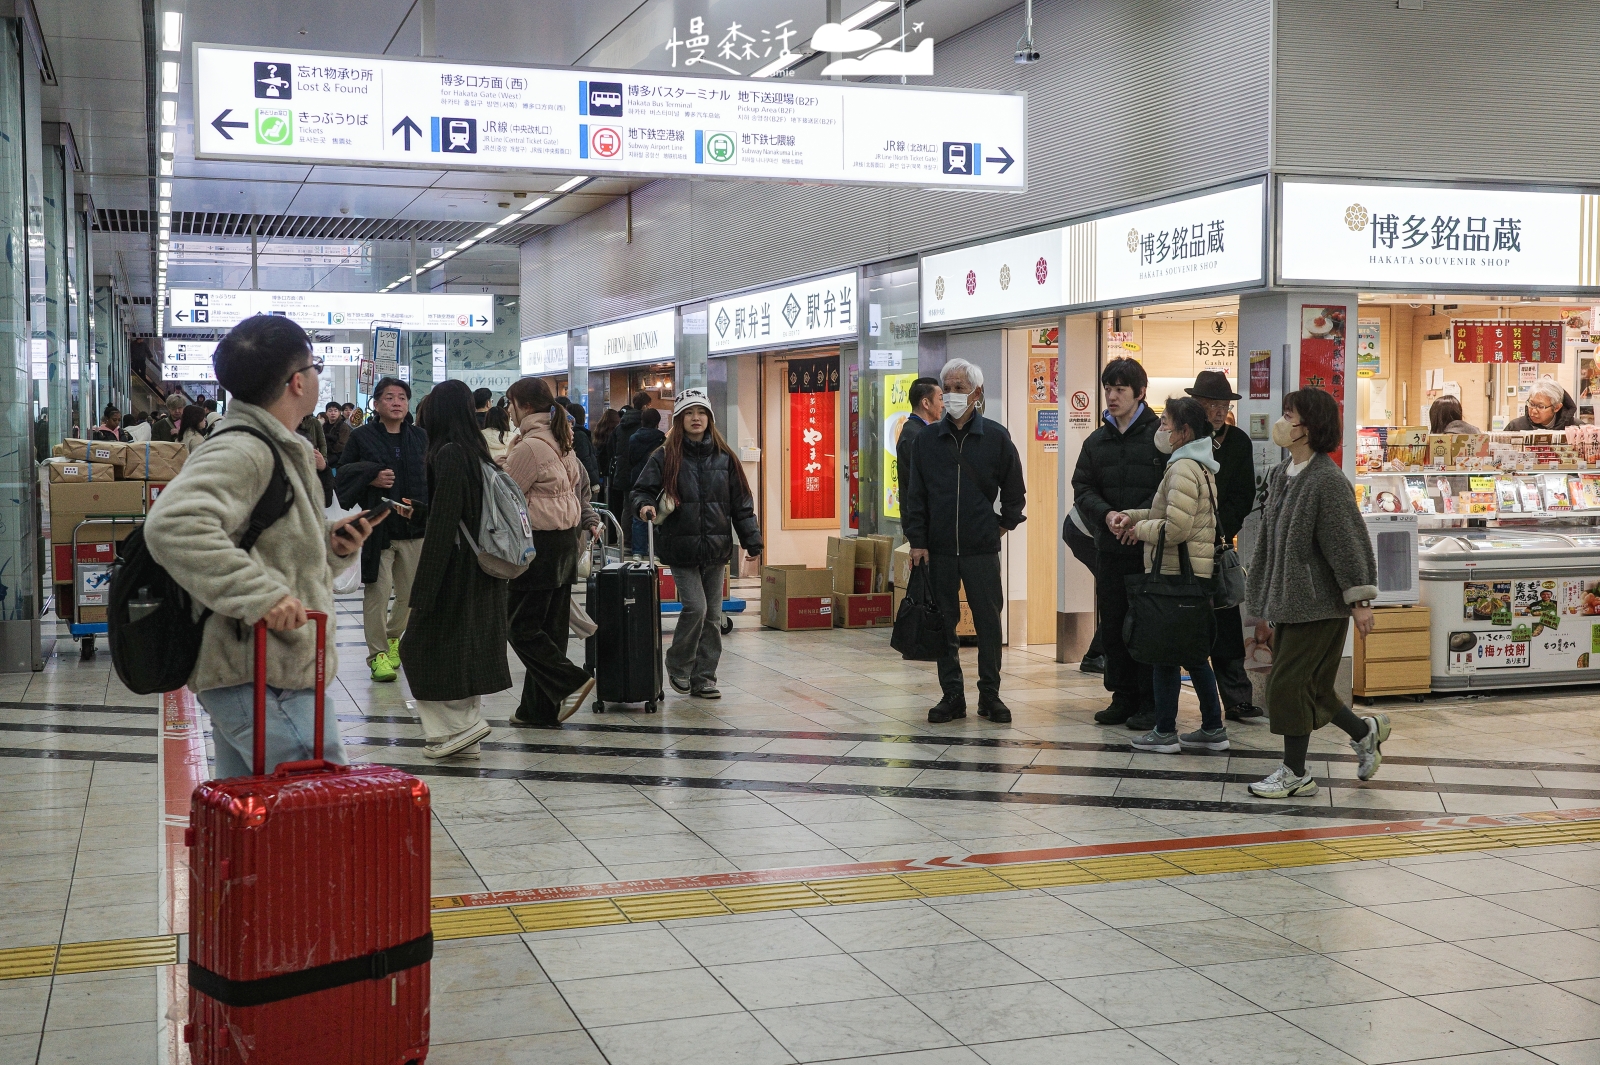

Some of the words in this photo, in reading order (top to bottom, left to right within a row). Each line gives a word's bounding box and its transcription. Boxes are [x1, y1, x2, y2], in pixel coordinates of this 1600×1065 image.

[298, 66, 373, 82] 忘れ物承り所
[298, 82, 319, 91] Lost
[323, 84, 331, 92] &
[335, 84, 368, 94] Found
[453, 89, 478, 98] Hakata
[628, 84, 730, 101] 博多バスターミナル
[628, 99, 649, 107] Hakata
[666, 101, 692, 109] Terminal
[737, 105, 759, 114] Pickup
[298, 112, 368, 126] きっぷうりば
[628, 127, 685, 142] 地下鉄空港線
[742, 133, 795, 147] 地下鉄七隈線
[628, 143, 649, 151] Subway
[651, 144, 668, 152] Airport
[742, 148, 762, 156] Subway
[1370, 214, 1522, 252] 博多銘品蔵
[1140, 220, 1225, 266] 博多銘品蔵
[1369, 256, 1414, 265] HAKATA
[1419, 257, 1476, 266] SOUVENIR
[1481, 258, 1511, 267] SHOP
[1139, 269, 1164, 280] HAKATA
[1165, 264, 1198, 277] SOUVENIR
[1200, 261, 1218, 273] SHOP
[806, 286, 851, 329] 駅弁当
[735, 302, 770, 340] 駅弁当
[380, 340, 394, 348] 入口
[607, 336, 626, 355] FORNO
[633, 330, 658, 350] MIGNON
[1458, 328, 1466, 361] むかん
[1495, 328, 1503, 361] もつ鍋
[1549, 328, 1558, 360] 明太子
[803, 427, 822, 474] やまや
[1527, 582, 1538, 601] もつ鍋
[472, 896, 522, 905] Elevator
[596, 887, 640, 895] Airport
